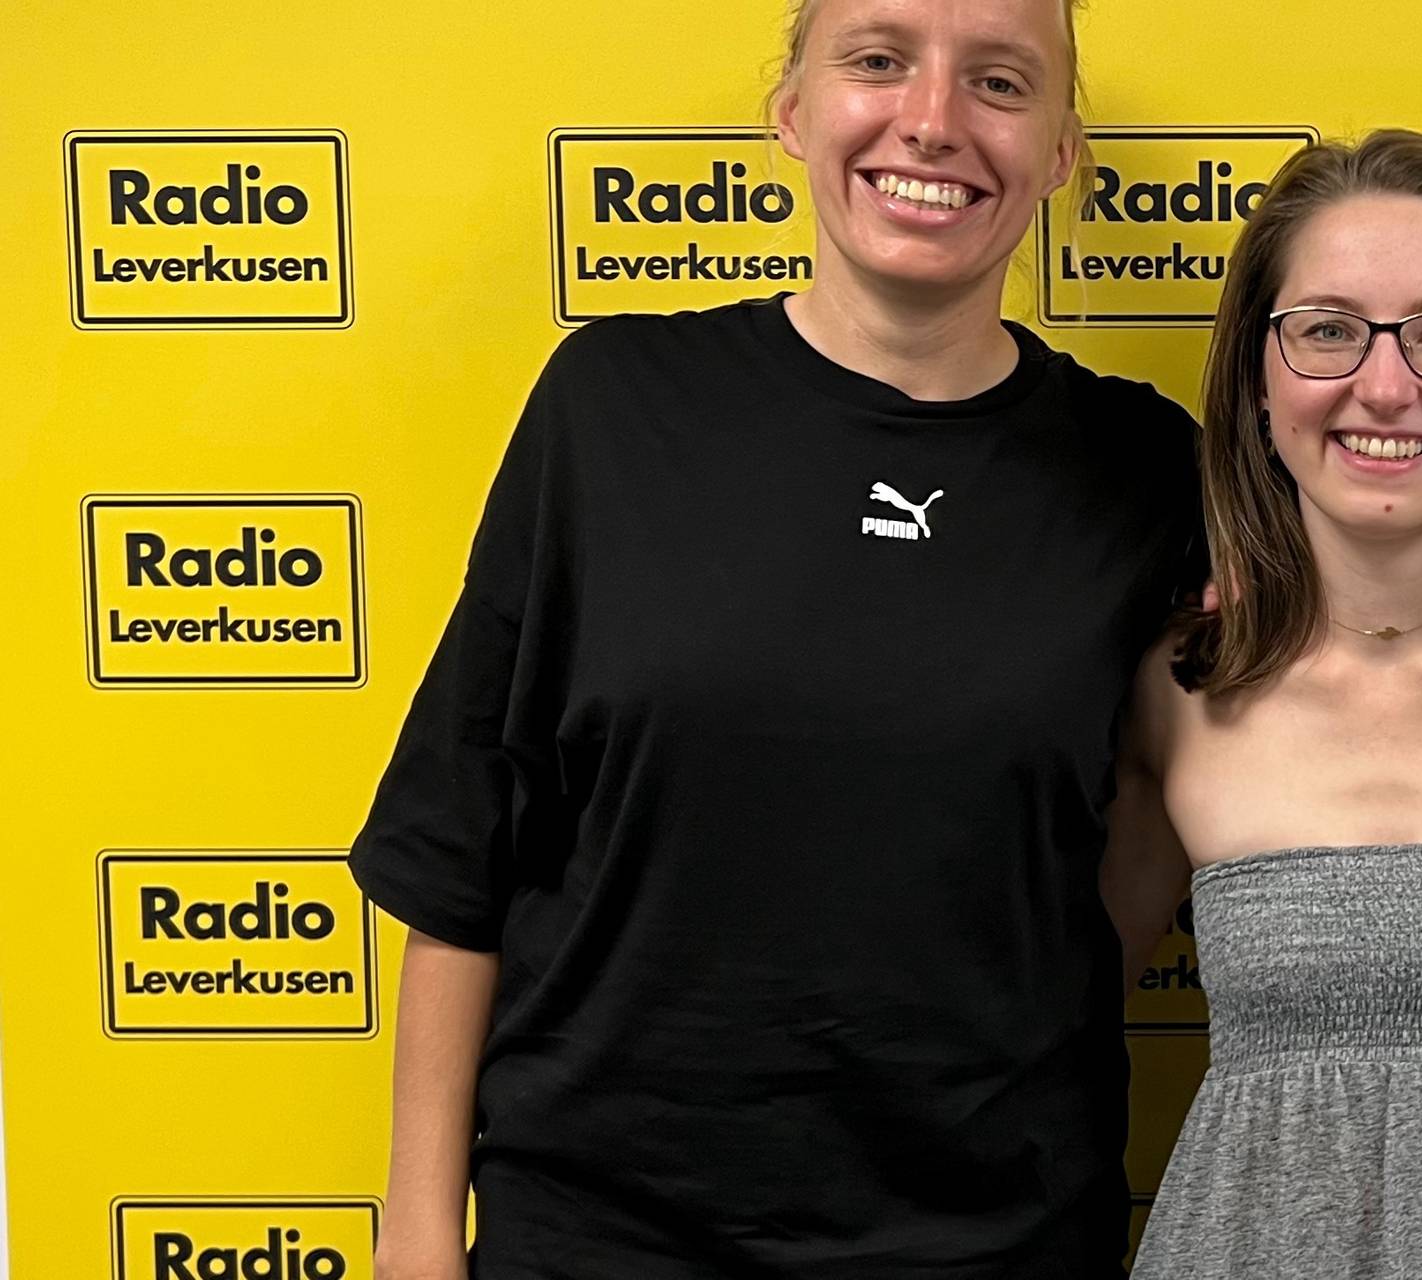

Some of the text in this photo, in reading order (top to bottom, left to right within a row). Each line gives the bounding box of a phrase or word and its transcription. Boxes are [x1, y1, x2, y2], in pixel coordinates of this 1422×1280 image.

[110, 163, 308, 226] Radio
[593, 161, 794, 224] Radio
[93, 244, 328, 283] Leverkusen
[576, 242, 813, 281] Leverkusen
[1062, 242, 1225, 280] Leverku
[862, 516, 919, 541] PUMA
[126, 527, 322, 587] Radio
[109, 606, 342, 643] Leverkusen
[140, 881, 335, 940] Radio
[124, 959, 354, 994] Leverkusen
[154, 1227, 346, 1280] Radio
